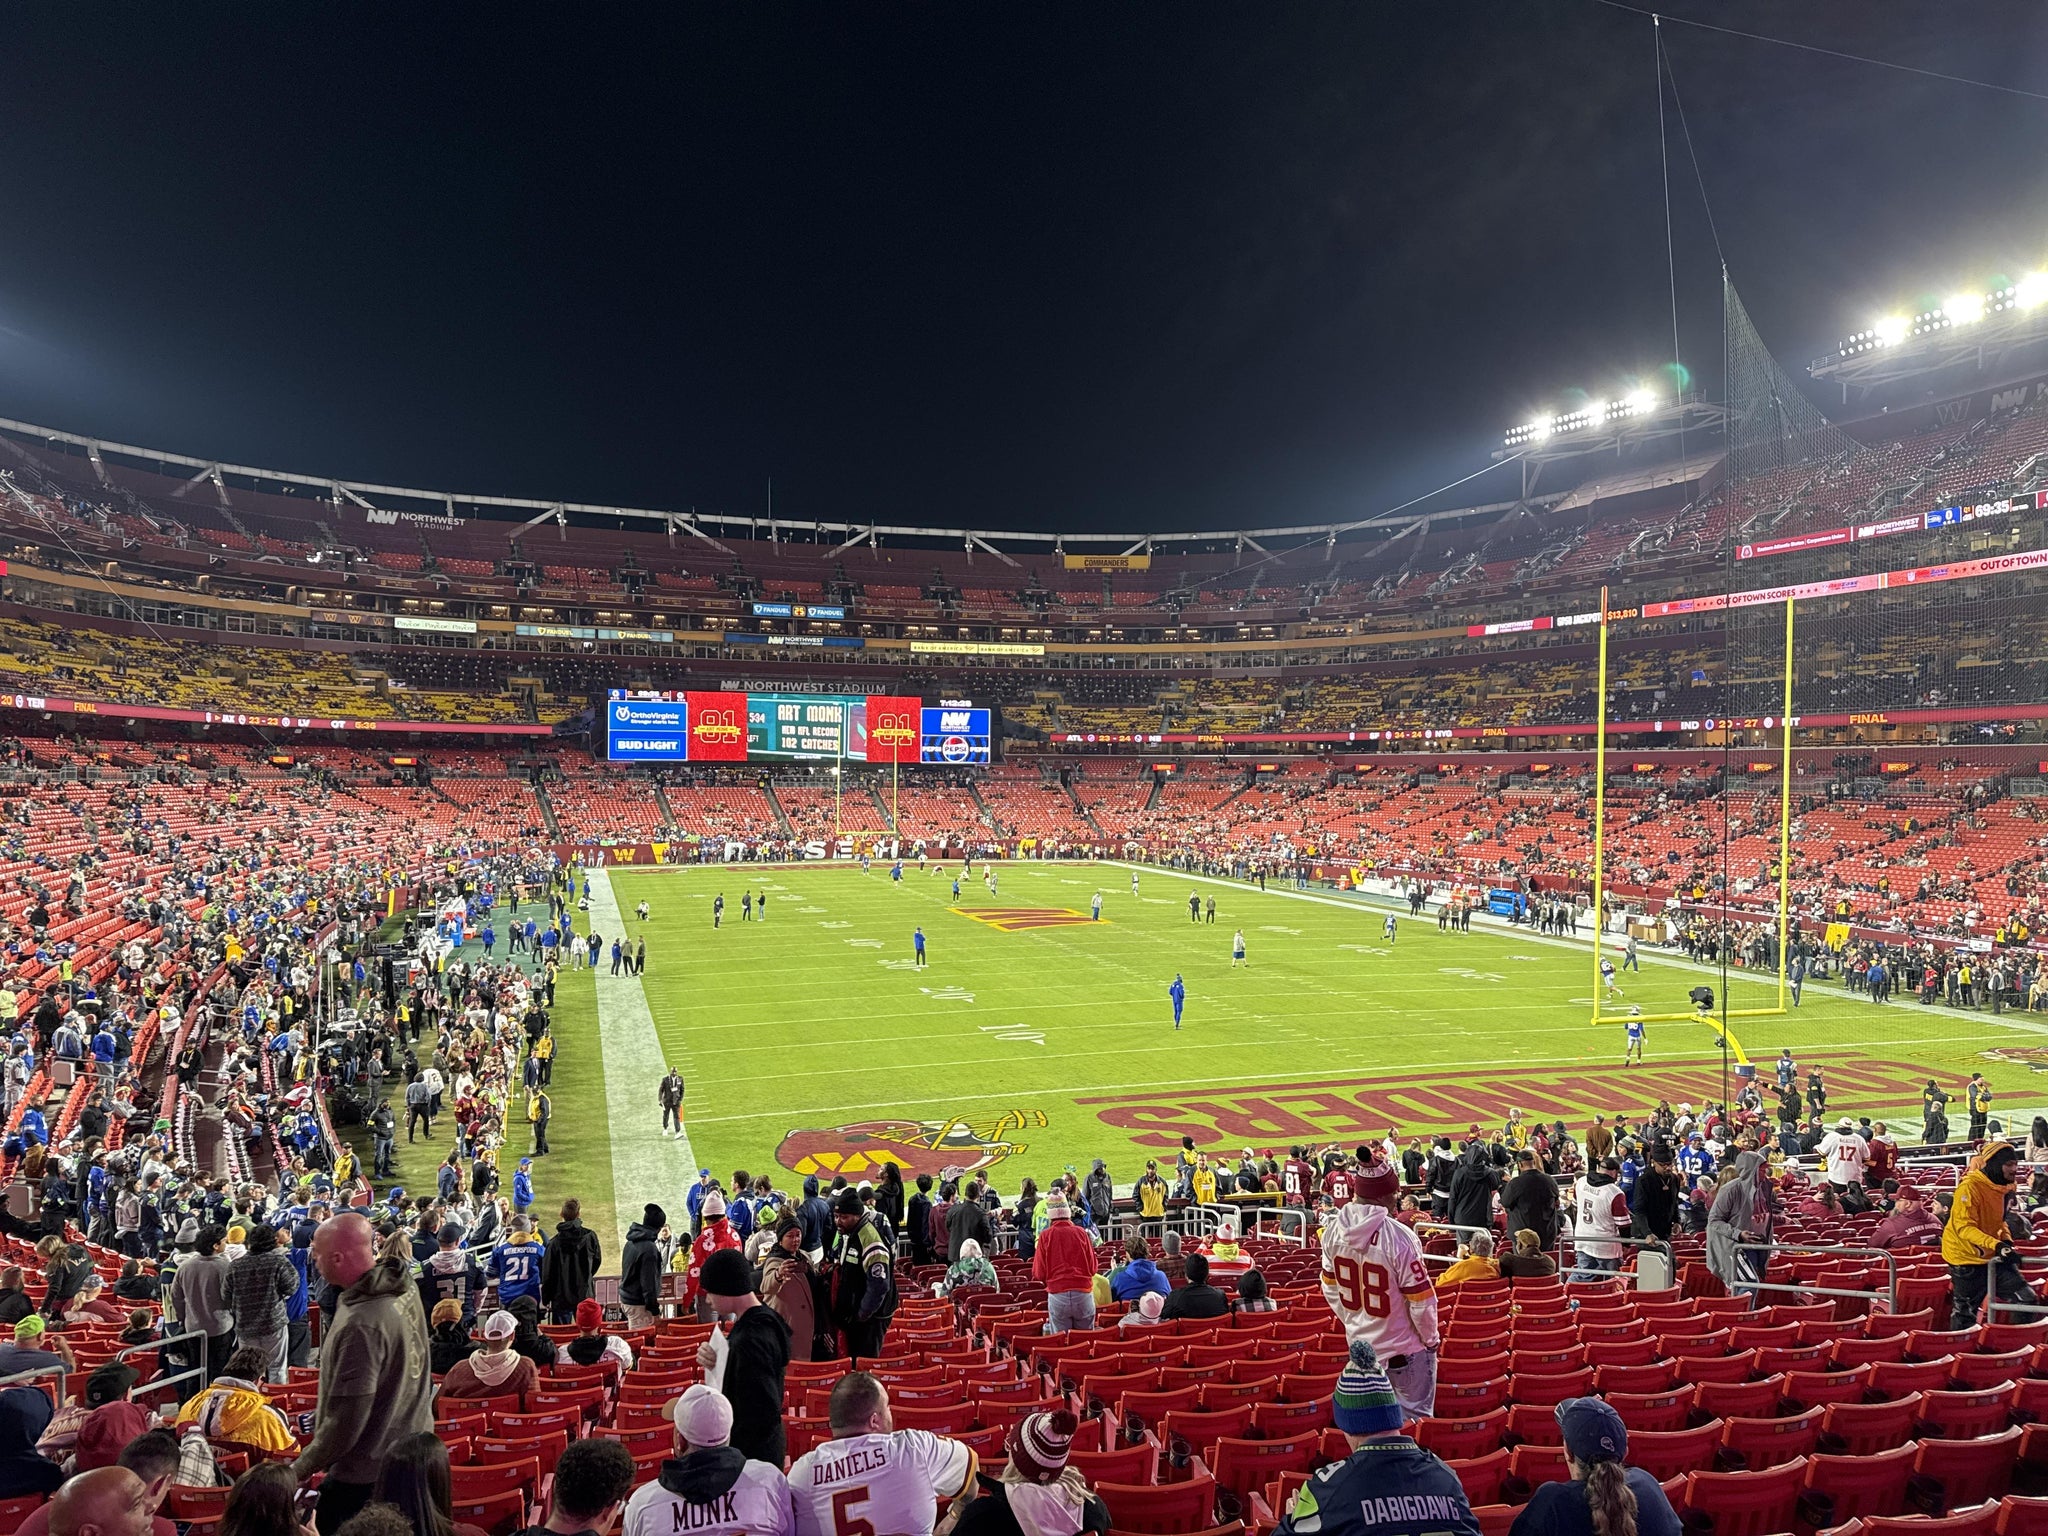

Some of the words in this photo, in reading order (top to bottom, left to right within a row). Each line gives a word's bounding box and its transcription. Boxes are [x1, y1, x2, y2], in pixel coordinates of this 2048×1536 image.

[1975, 500, 2010, 517] 69:35
[366, 509, 399, 525] NW
[401, 512, 466, 526] NORTHWEST
[414, 521, 453, 531] STADIUM
[1876, 517, 1919, 531] NORTHWEST
[1084, 559, 1129, 567] COMMANDERS
[1981, 560, 2001, 571] OUT
[2001, 558, 2015, 568] OF
[2016, 553, 2048, 565] TOWN
[1717, 595, 1734, 606] OUT
[1733, 595, 1743, 604] OF
[1743, 592, 1766, 602] TOWN
[1767, 589, 1796, 599] SCORES
[1608, 609, 1638, 620] $13,810
[547, 628, 573, 636] FANDUEL
[743, 681, 825, 692] NORTHWEST
[828, 683, 886, 694] STADIUM
[1, 695, 12, 705] 20
[27, 697, 46, 709] TEN
[74, 702, 97, 713] FINAL
[249, 716, 260, 725] 23
[267, 717, 278, 726] 23
[298, 719, 310, 727] LV
[630, 711, 680, 720] OrthoVirginia
[777, 704, 801, 721] ART
[806, 705, 843, 723] MONK
[1680, 720, 1700, 730] IND
[1744, 719, 1759, 728] 27
[1849, 714, 1888, 724] FINAL
[700, 709, 738, 743] 81
[797, 726, 810, 736] NFL
[812, 726, 839, 737] RECORD
[878, 713, 913, 746] 81
[1435, 730, 1452, 738] NYG
[1482, 728, 1508, 736] FINAL
[617, 741, 643, 750] BUD
[644, 741, 678, 750] LIGHT
[747, 734, 759, 742] LEFT
[781, 737, 798, 748] 102
[801, 738, 839, 751] CATCHES
[977, 1022, 1047, 1041] 10
[1838, 1146, 1856, 1162] 17
[1684, 1155, 1702, 1176] 12
[1285, 1172, 1301, 1194] 81
[1333, 1183, 1350, 1199] 81
[1583, 1198, 1593, 1225] 5
[504, 1256, 530, 1282] 21
[436, 1277, 466, 1303] 31
[1333, 1256, 1391, 1318] 98
[813, 1447, 887, 1487] DANIELS
[671, 1490, 739, 1533] MONK
[831, 1484, 876, 1536] 5
[1360, 1494, 1461, 1526] DABIGDAWG
